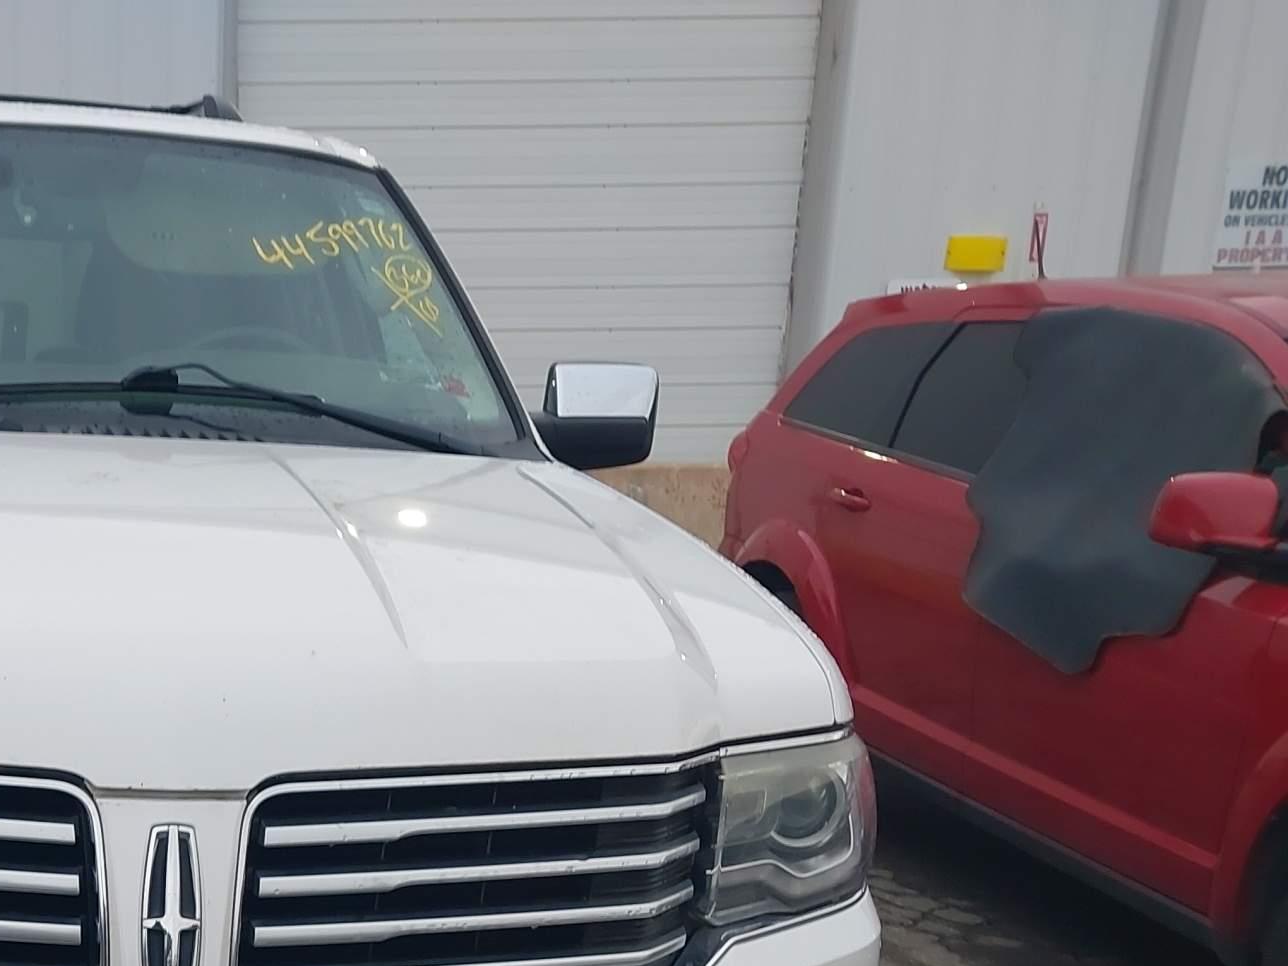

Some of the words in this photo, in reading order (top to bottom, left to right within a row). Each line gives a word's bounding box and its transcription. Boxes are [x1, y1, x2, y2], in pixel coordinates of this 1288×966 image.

[1262, 165, 1288, 187] NO
[1223, 214, 1241, 228] ON
[252, 217, 411, 270] 44599762
